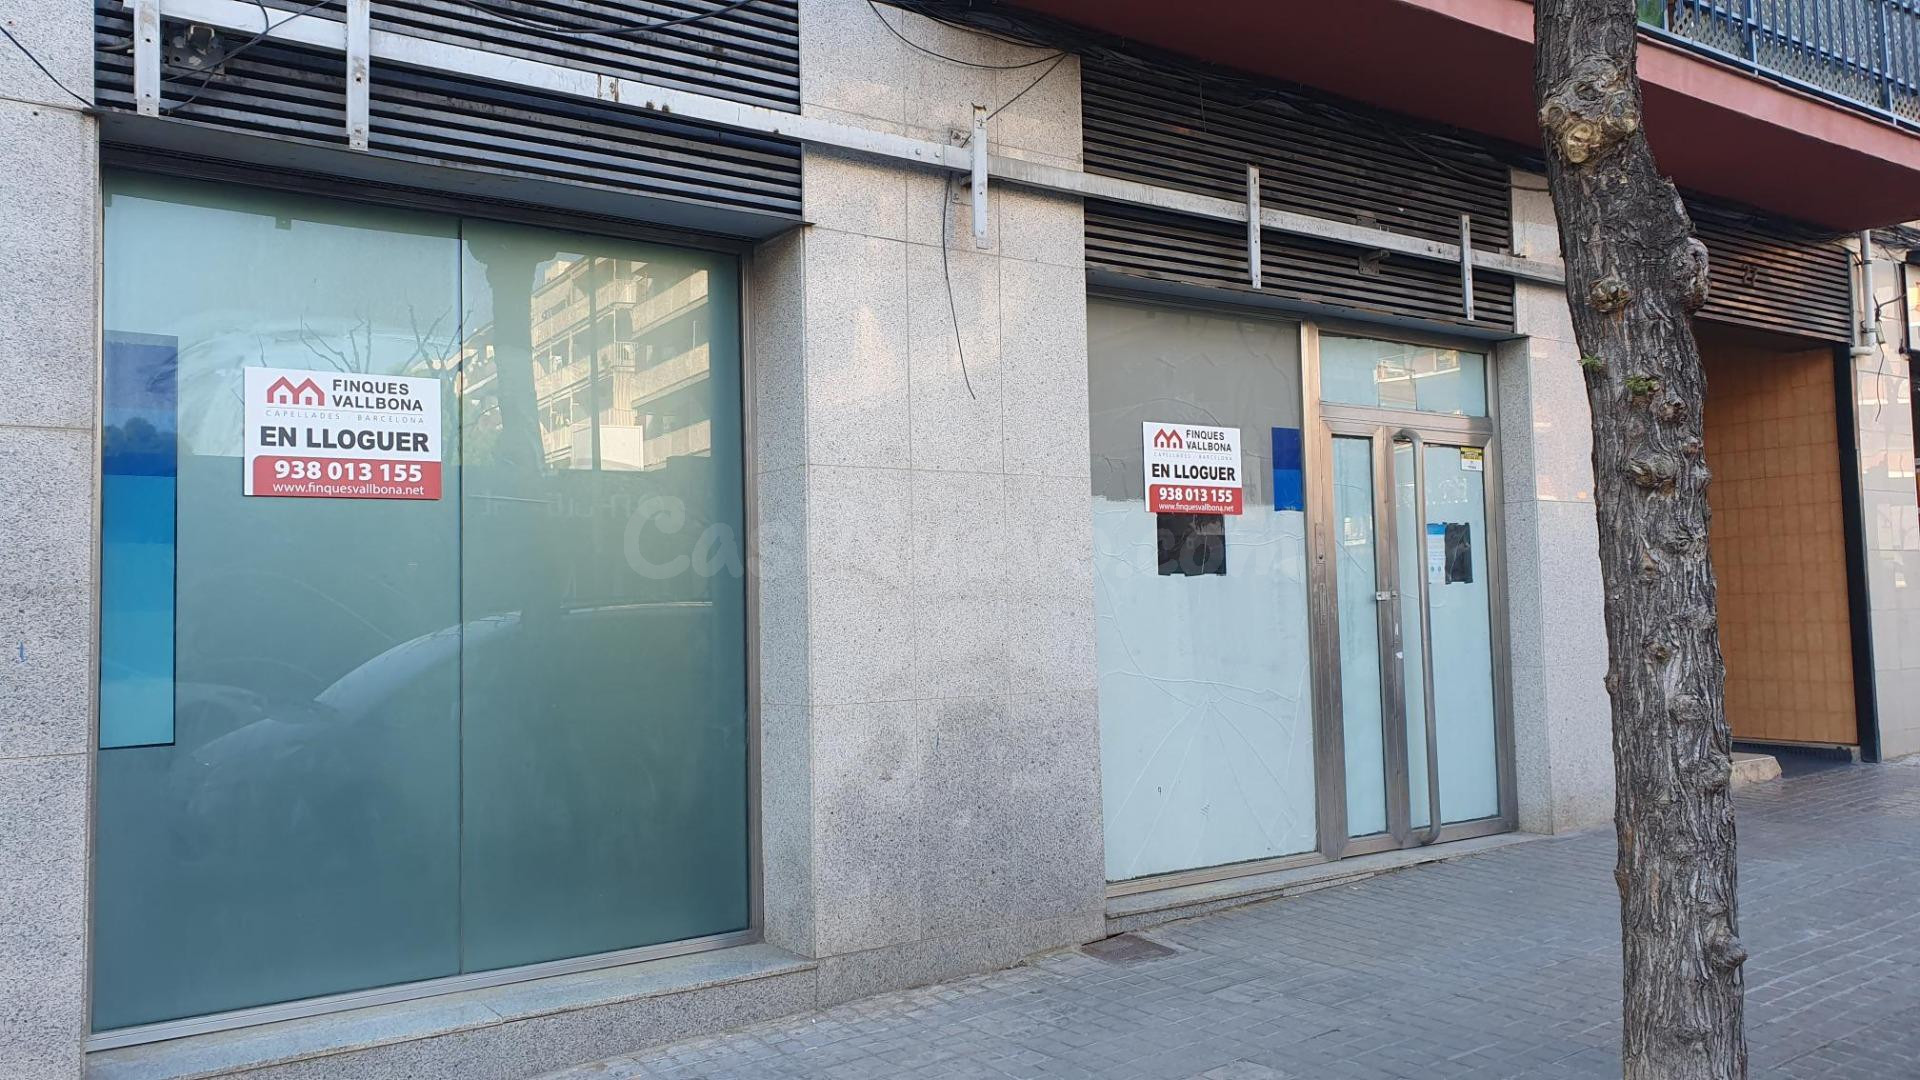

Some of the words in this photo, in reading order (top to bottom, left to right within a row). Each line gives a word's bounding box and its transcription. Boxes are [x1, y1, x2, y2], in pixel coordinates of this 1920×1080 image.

[332, 379, 409, 395] FINQUES
[332, 395, 423, 412] VALLBONA
[265, 410, 341, 420] CAPELLADES
[357, 414, 424, 424] BARCELONA
[260, 426, 297, 447] EN
[306, 427, 430, 453] LLOGUER
[1186, 429, 1225, 441] FINQUES
[1186, 441, 1232, 452] VALLBONA
[274, 460, 322, 480] 938
[327, 462, 373, 481] 013
[379, 463, 423, 482] 155
[1151, 463, 1170, 478] EN
[1174, 464, 1236, 481] LLOGUER
[272, 482, 425, 496] www.finquesvallbona.net
[1159, 487, 1183, 501] 938
[1185, 488, 1208, 502] 013
[1210, 489, 1233, 503] 155
[1158, 503, 1234, 512] www.finquesvallbona.net
